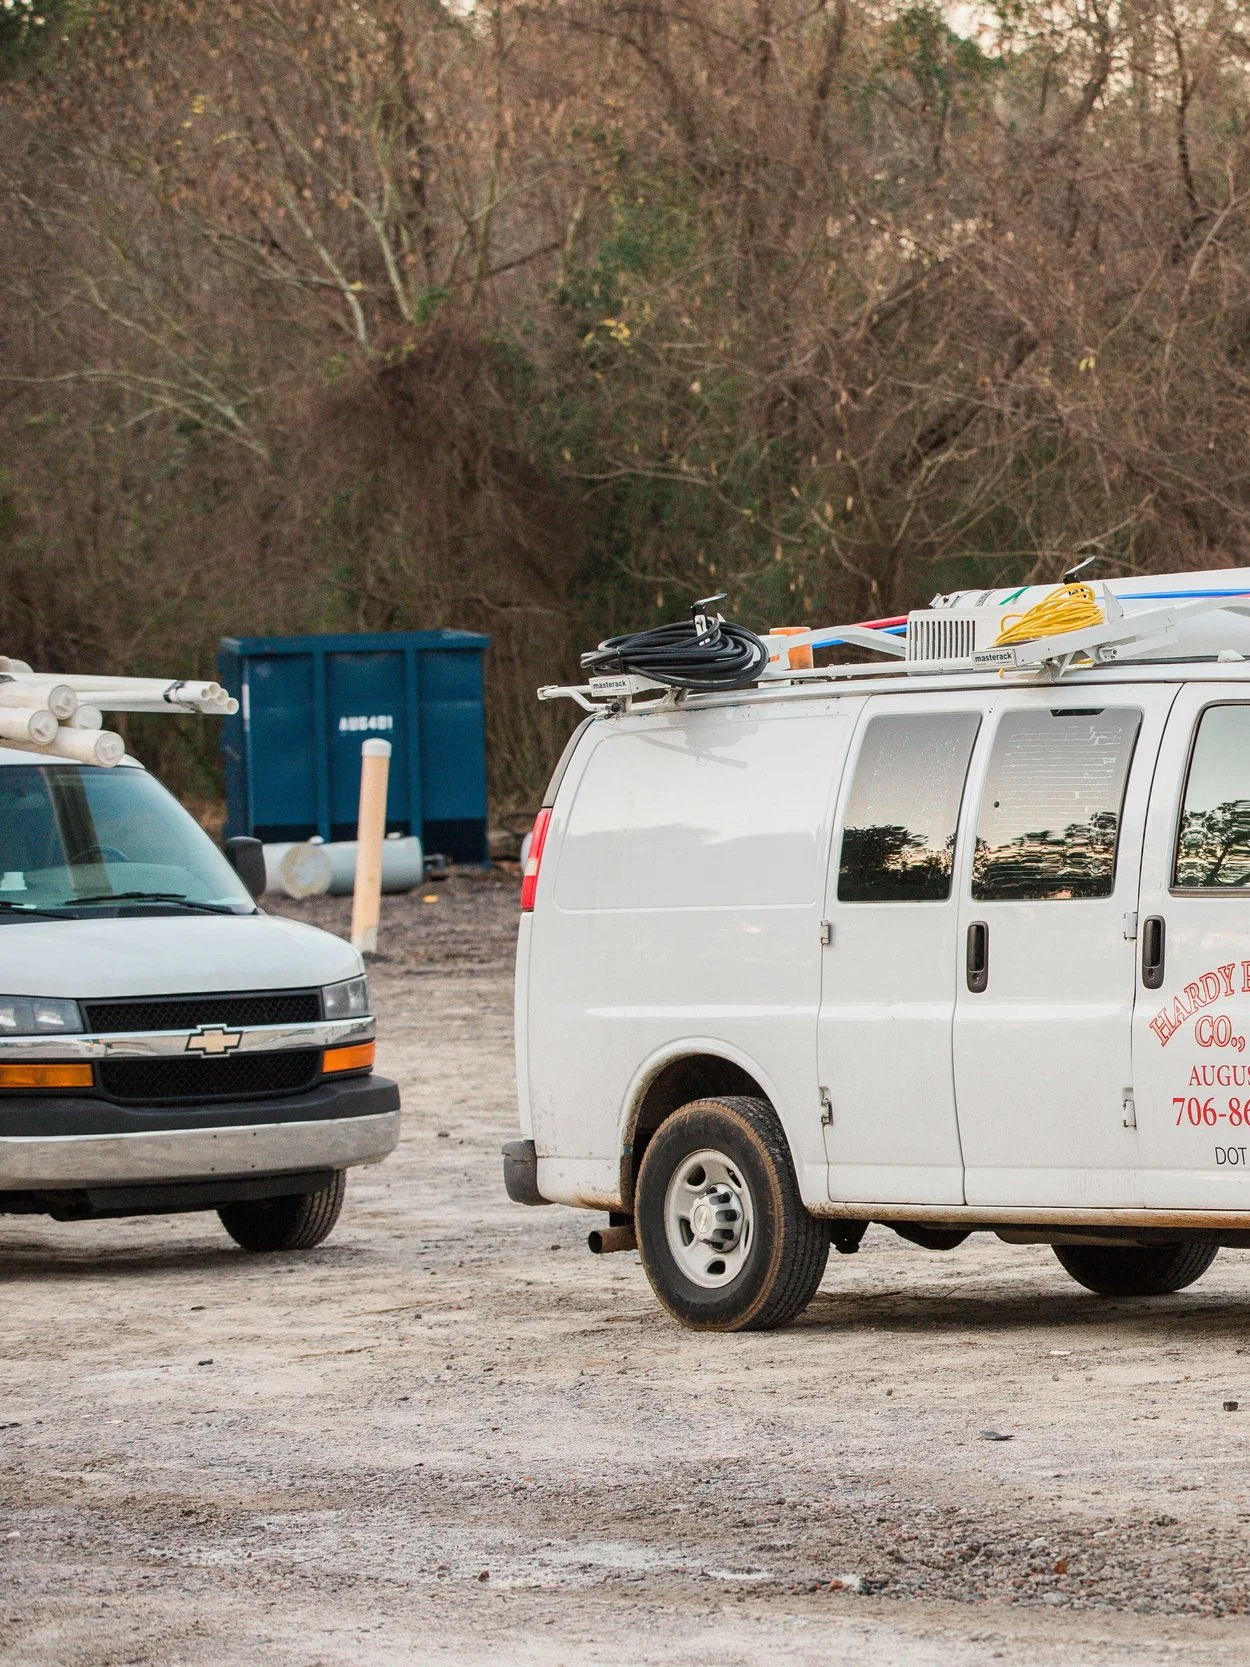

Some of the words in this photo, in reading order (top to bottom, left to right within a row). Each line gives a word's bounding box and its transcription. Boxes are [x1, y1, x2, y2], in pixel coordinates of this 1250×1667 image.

[974, 652, 1013, 662] masterack
[592, 680, 627, 689] masterack
[1149, 963, 1236, 1047] HARDY
[1194, 1014, 1246, 1053] CO.,
[1214, 1146, 1248, 1166] DOT
